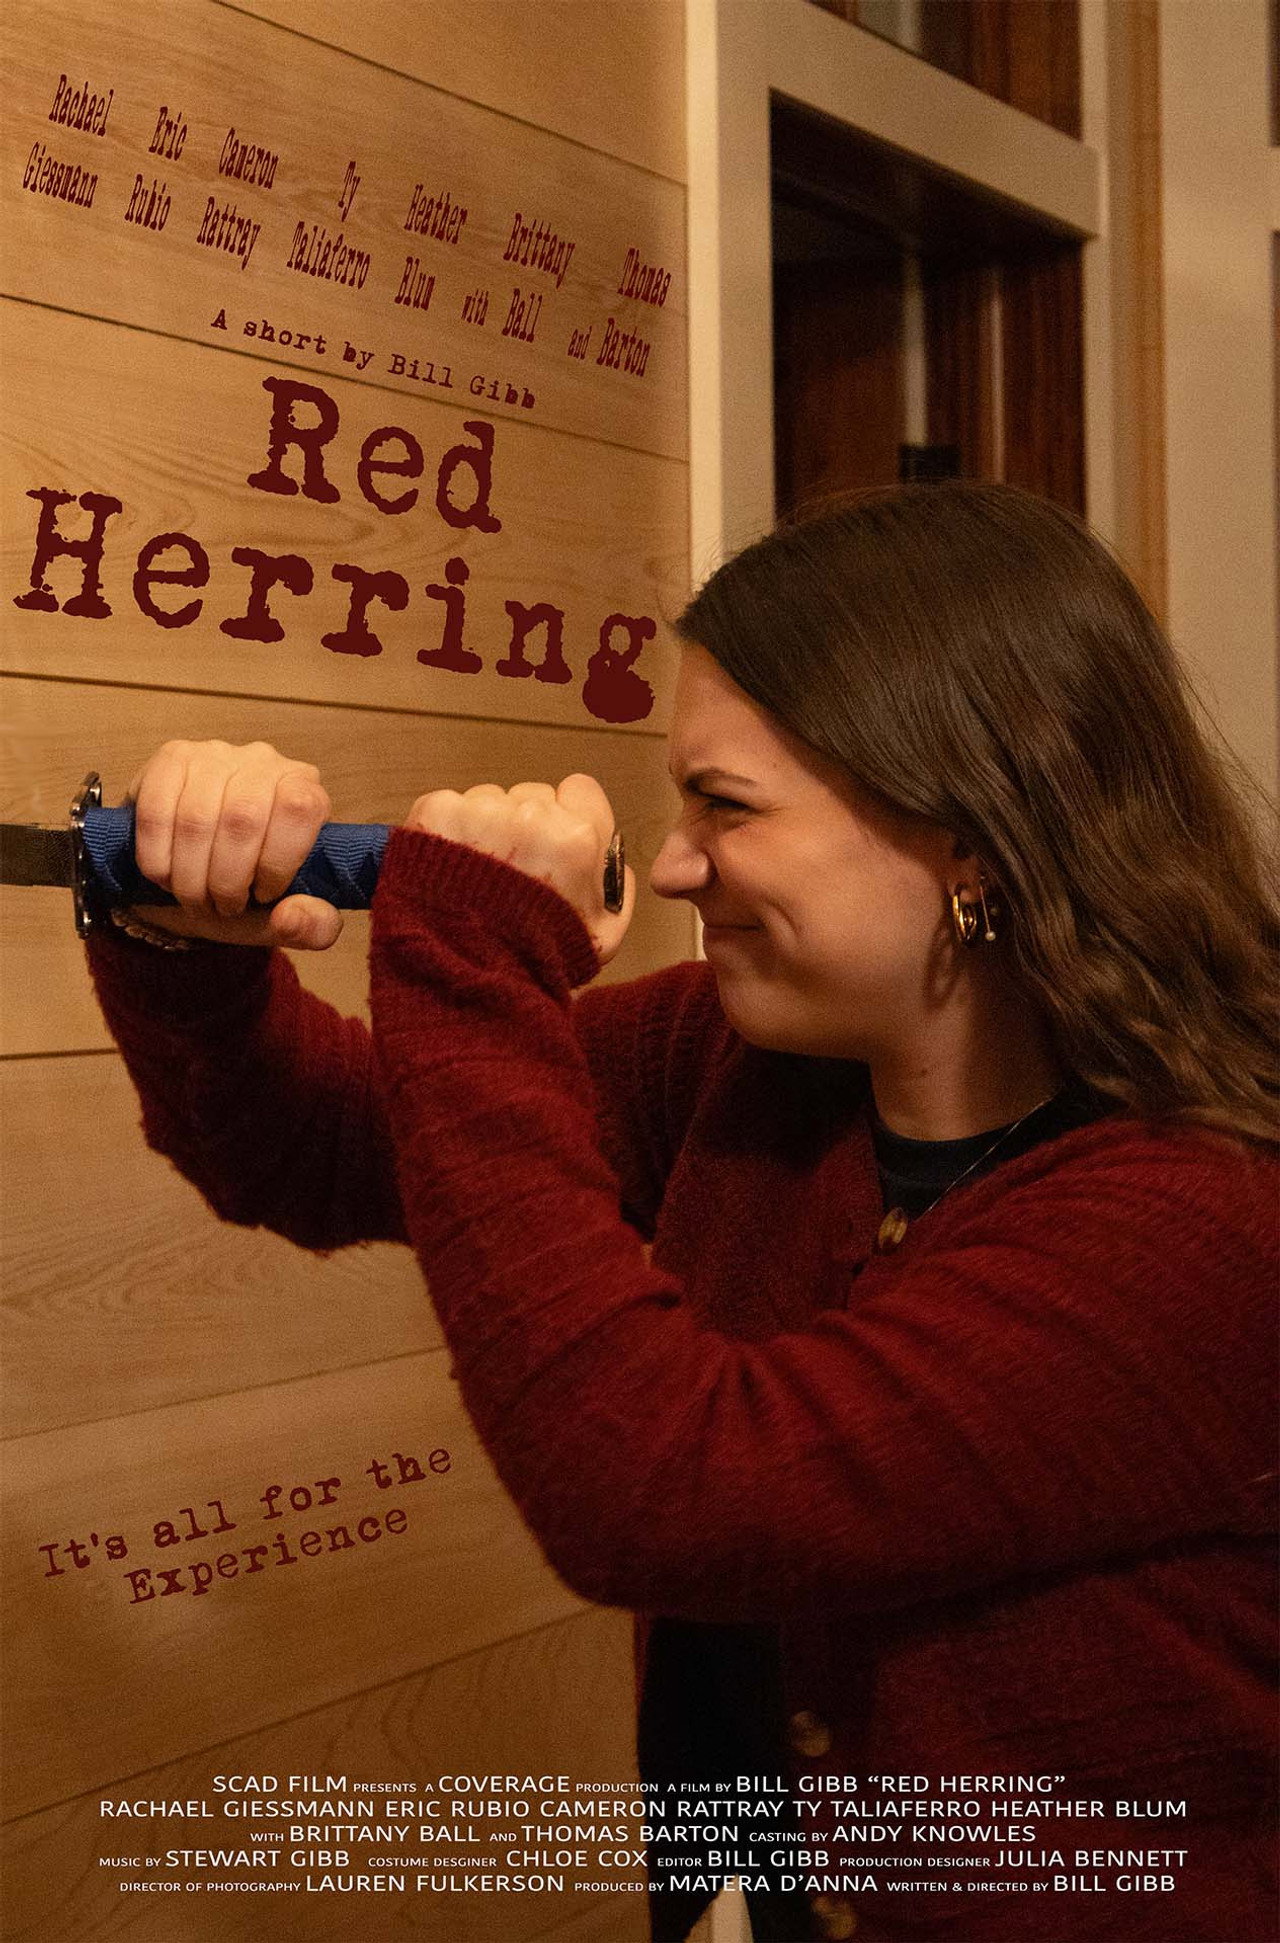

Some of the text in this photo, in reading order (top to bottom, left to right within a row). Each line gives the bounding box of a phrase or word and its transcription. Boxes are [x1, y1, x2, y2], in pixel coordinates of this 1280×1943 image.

[48, 74, 672, 309] Rachael Eric Cameron Ty Heather Brittany Thomas
[22, 142, 652, 379] Giessmann Rubio Rattray Taliaferro Blum with Ball and Barton
[211, 310, 536, 410] A short by Bill Gibb
[247, 376, 501, 534] Red
[13, 487, 657, 723] Herring
[38, 1447, 452, 1578] It's all for the
[124, 1508, 409, 1604] Experience
[100, 1800, 1186, 1818] RACHAEL GIESSMANN ERIC RUBIO CAMERON RATTRAY TY TALIAFERRO HEATHER BLUM
[212, 1775, 278, 1793] SCAD
[289, 1775, 347, 1793] FILM
[353, 1783, 417, 1793] PRESENTS
[425, 1783, 434, 1793] A
[438, 1775, 570, 1793] COVERAGE
[576, 1783, 659, 1793] PRODUCTION
[667, 1783, 677, 1793] A
[680, 1783, 710, 1793] FILM
[715, 1783, 732, 1793] BY
[736, 1775, 789, 1793] BILL
[798, 1775, 858, 1793] GIBB
[99, 1850, 1188, 1867] MUSIC BY STEWART GIBB COSTUME DESGINER CHLOE COX EDITOR BILL GIBB PRODUCTION DESIGNER JULIA BENNETT
[250, 1825, 1036, 1842] WITH BRITTANY BALL AND THOMAS BARTON CASTING BY ANDY KNOWLES
[120, 1882, 181, 1892] DIRECTOR
[185, 1882, 202, 1892] OF
[206, 1882, 301, 1892] PHOTOGRAPHY
[306, 1875, 405, 1892] LAUREN
[417, 1875, 564, 1892] FULKERSON
[574, 1882, 644, 1892] PRODUCED
[648, 1882, 665, 1892] BY
[670, 1875, 771, 1892] MATERA
[886, 1882, 947, 1892] WRITTEN
[952, 1882, 963, 1892] &
[967, 1882, 1028, 1892] DIRECTED
[1032, 1882, 1049, 1892] BY
[1054, 1875, 1107, 1892] BILL
[1116, 1875, 1175, 1892] GIBB
